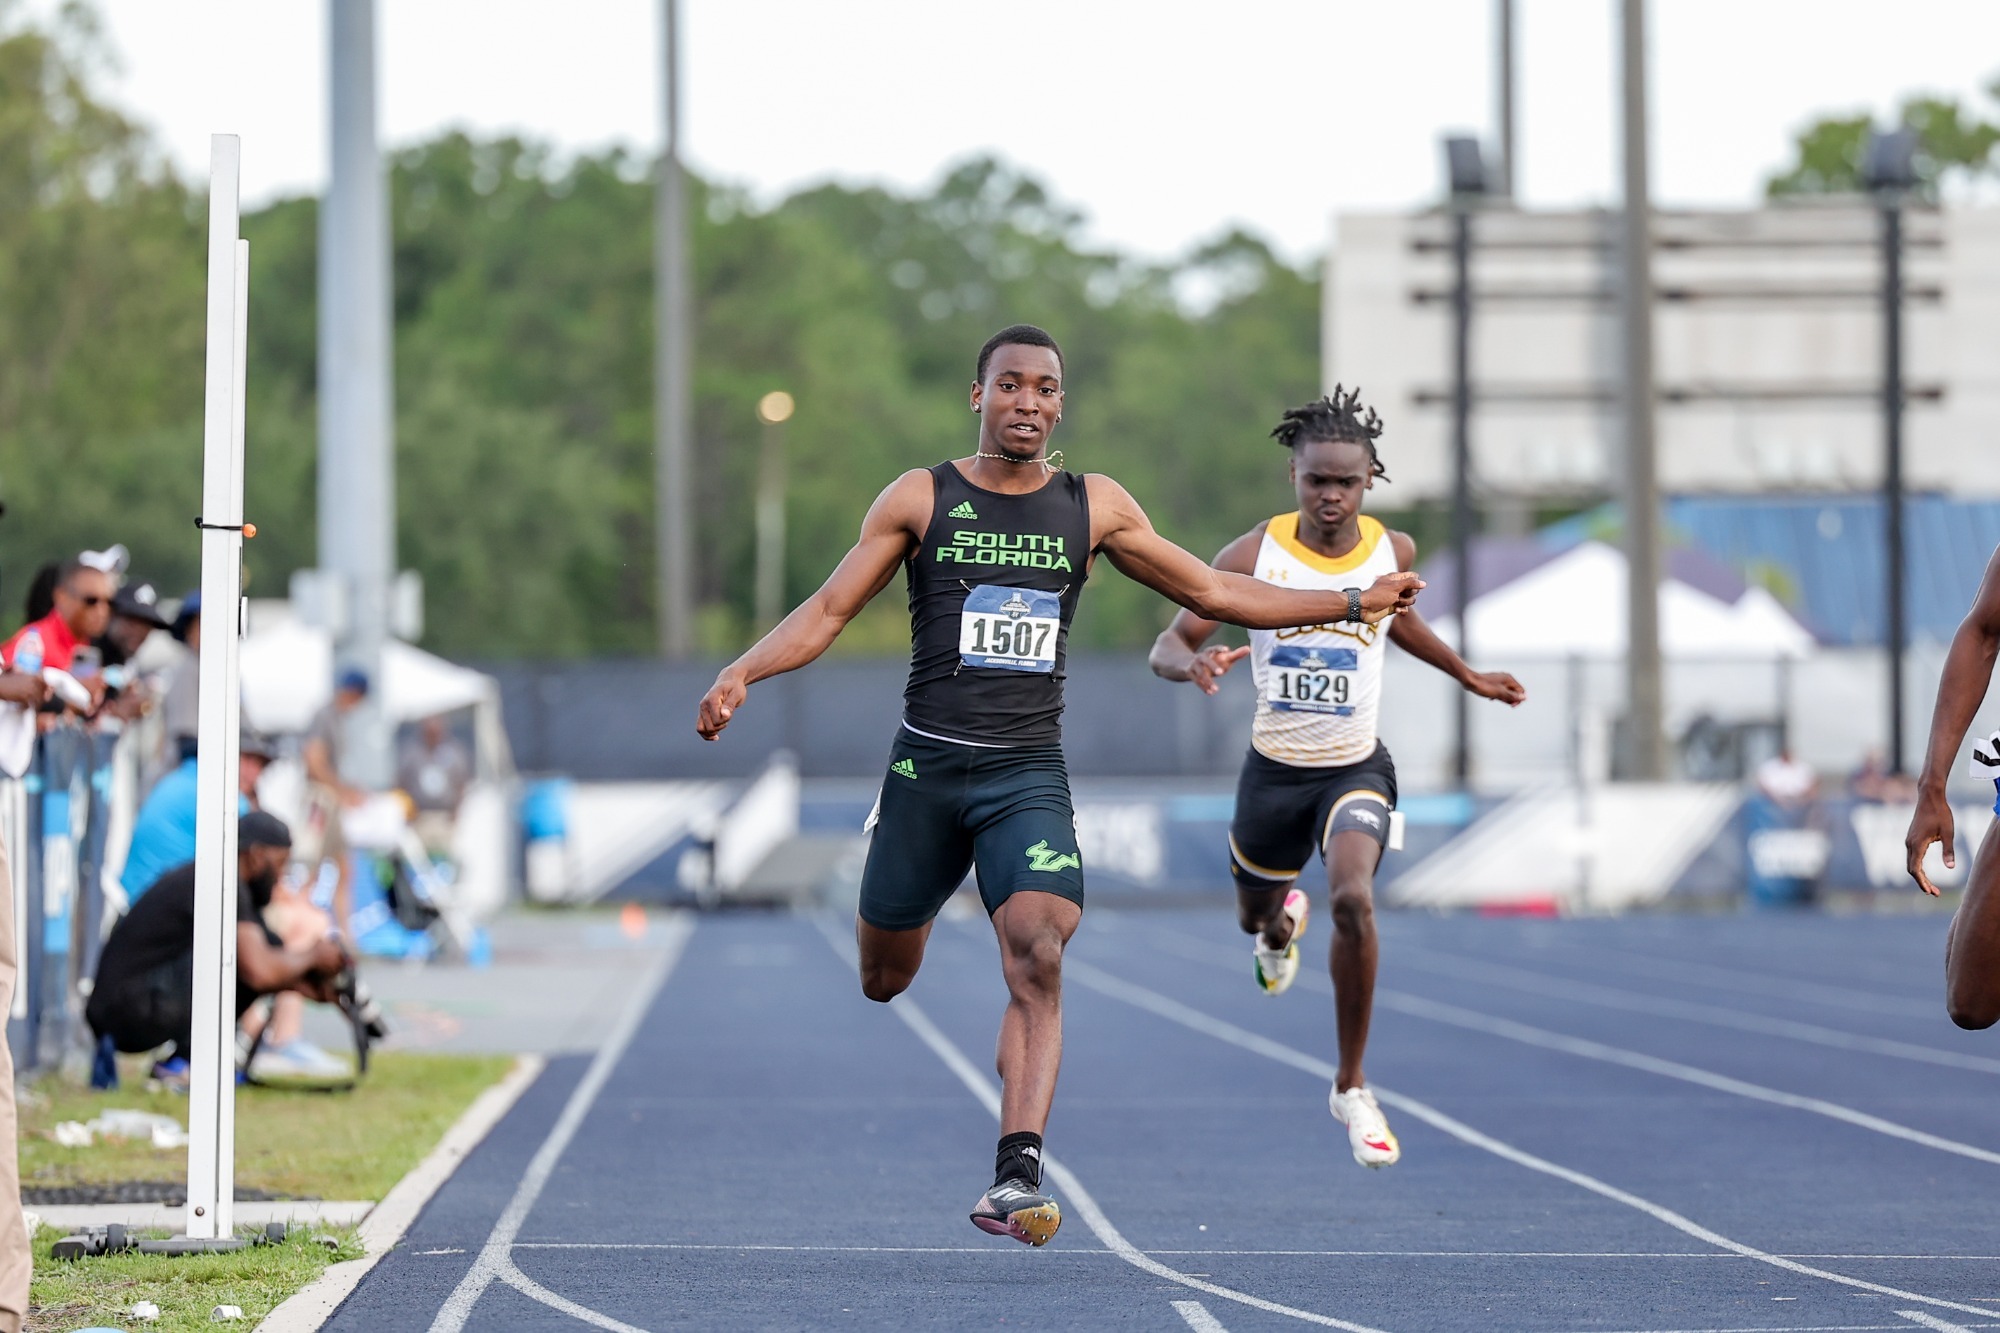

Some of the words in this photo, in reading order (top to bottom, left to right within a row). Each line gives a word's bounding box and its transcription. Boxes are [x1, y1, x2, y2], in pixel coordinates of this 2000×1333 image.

[948, 511, 977, 519] adidas
[952, 530, 1064, 553] SOUTH
[936, 547, 1072, 573] FLORIDA
[971, 618, 1051, 657] 1507
[1278, 672, 1348, 704] 1629
[891, 764, 918, 780] adidas
